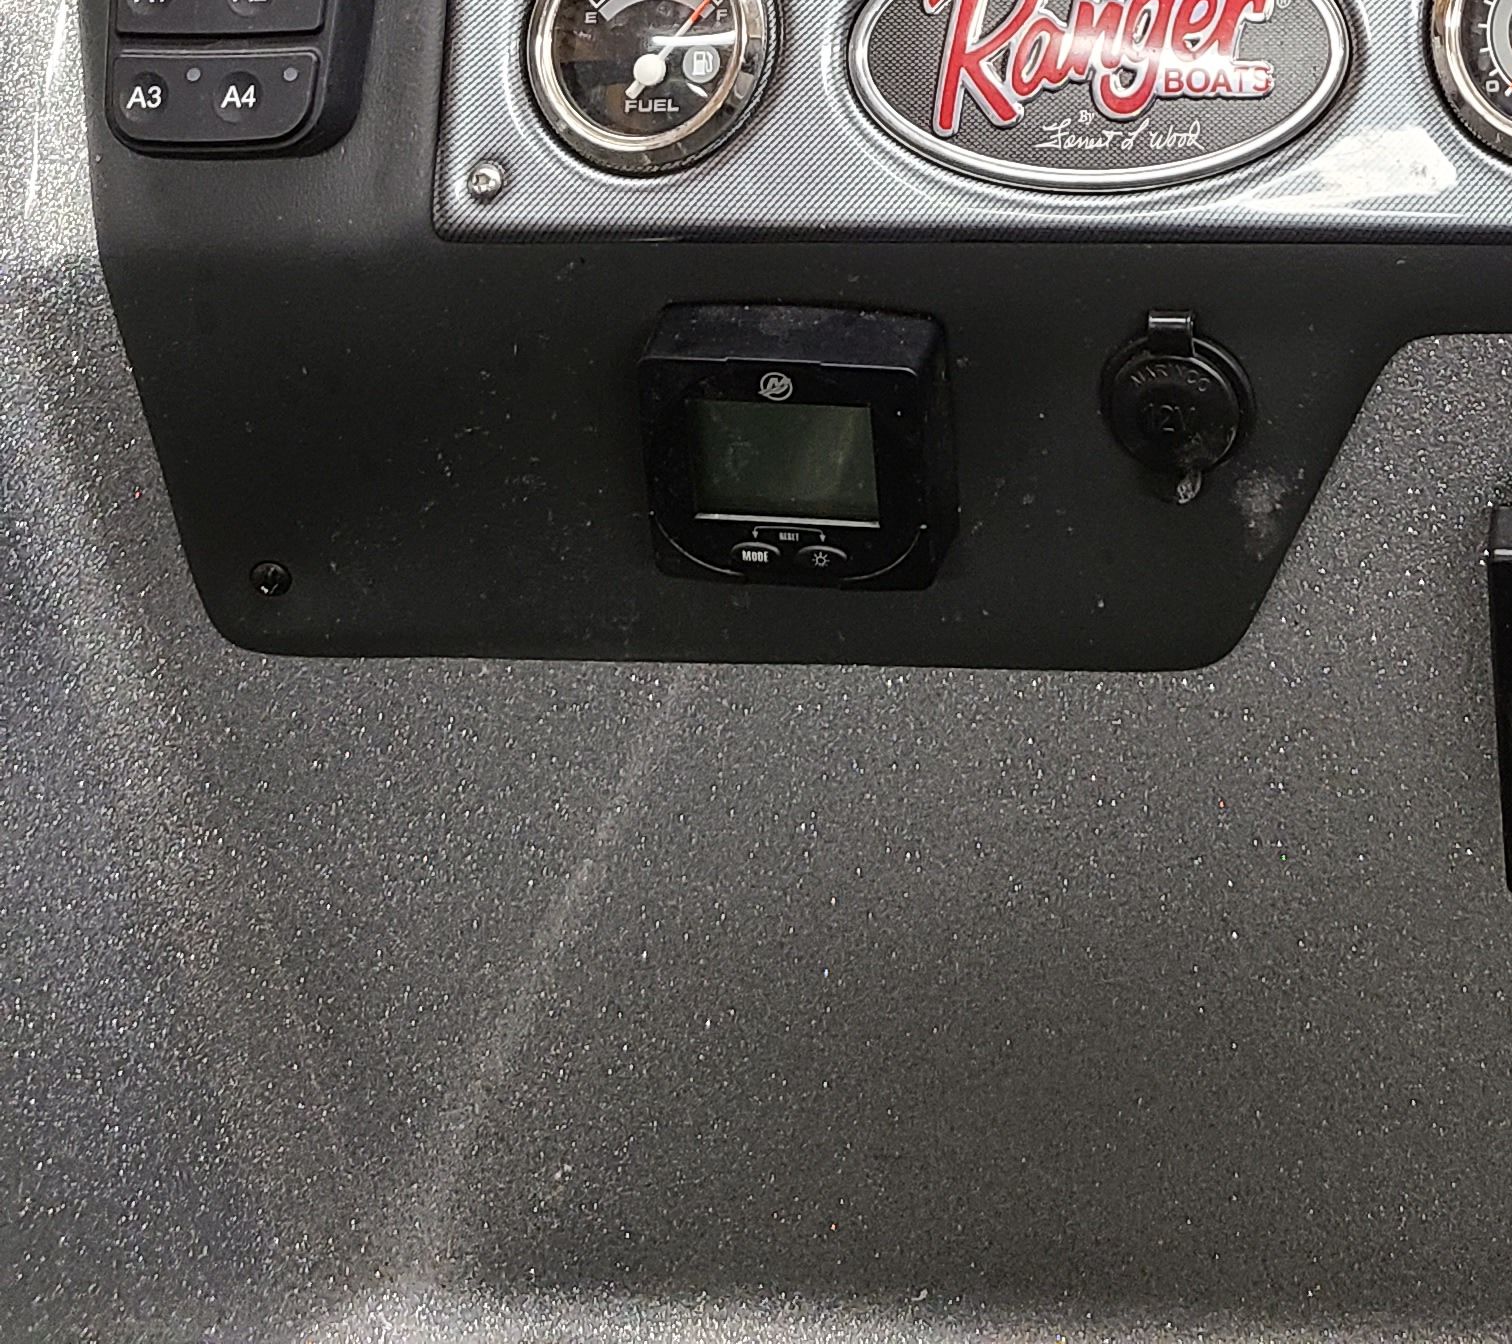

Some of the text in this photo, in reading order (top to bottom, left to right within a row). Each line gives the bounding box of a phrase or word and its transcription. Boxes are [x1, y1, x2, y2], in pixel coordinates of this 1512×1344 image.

[585, 12, 597, 24] E
[716, 10, 728, 21] F
[1163, 67, 1274, 96] BOATS
[1486, 80, 1500, 93] 0
[127, 85, 162, 108] A3
[221, 85, 256, 109] A4
[624, 99, 679, 113] FUEL
[1078, 110, 1095, 125] By
[1149, 120, 1204, 151] Wood
[742, 550, 769, 562] MODE
